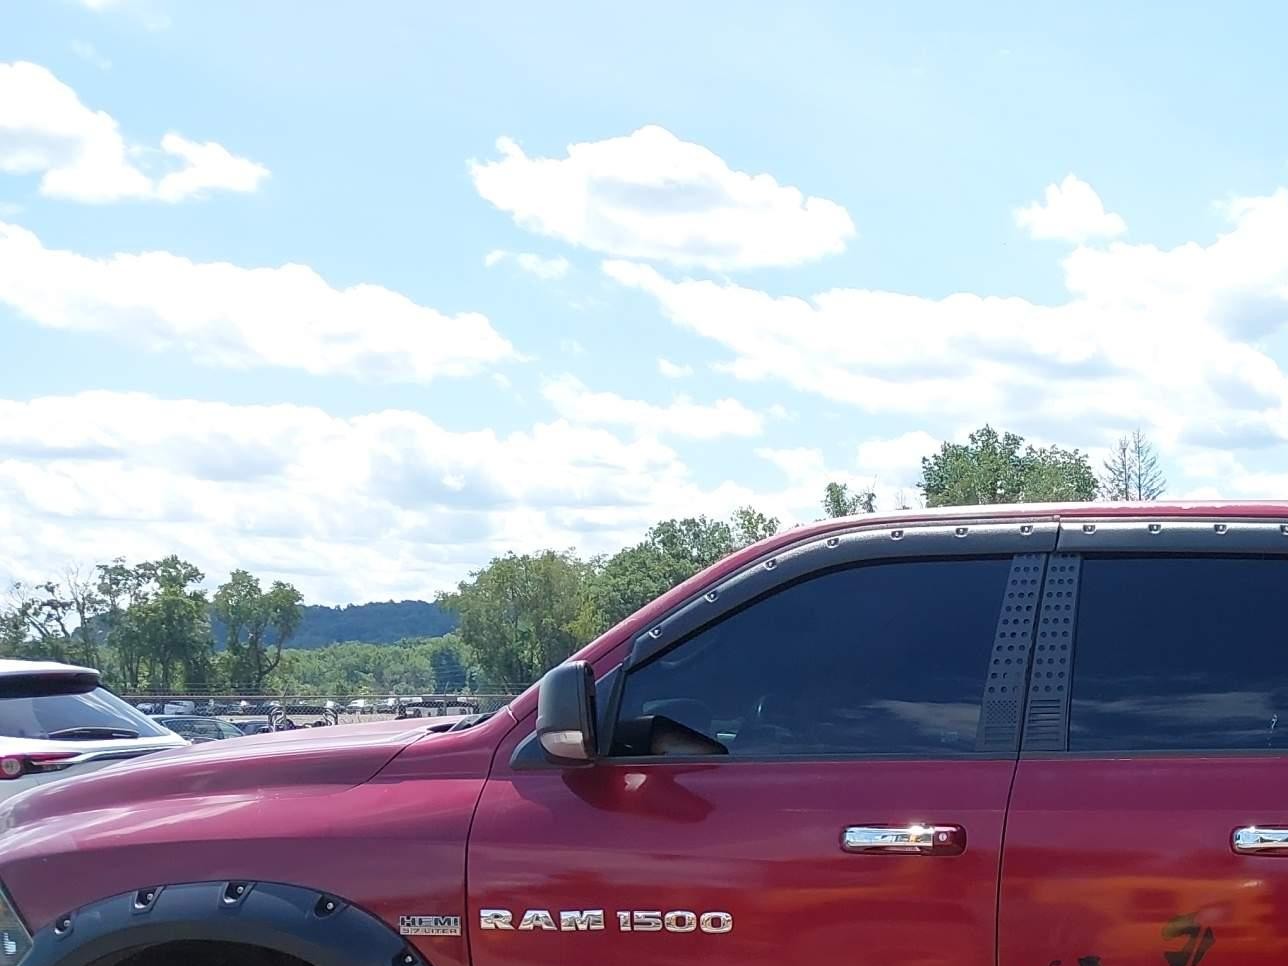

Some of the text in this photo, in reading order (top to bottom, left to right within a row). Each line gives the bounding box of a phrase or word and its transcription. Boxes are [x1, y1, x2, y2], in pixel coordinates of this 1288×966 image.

[400, 916, 460, 927] HEMI
[480, 909, 733, 934] RAM 1500
